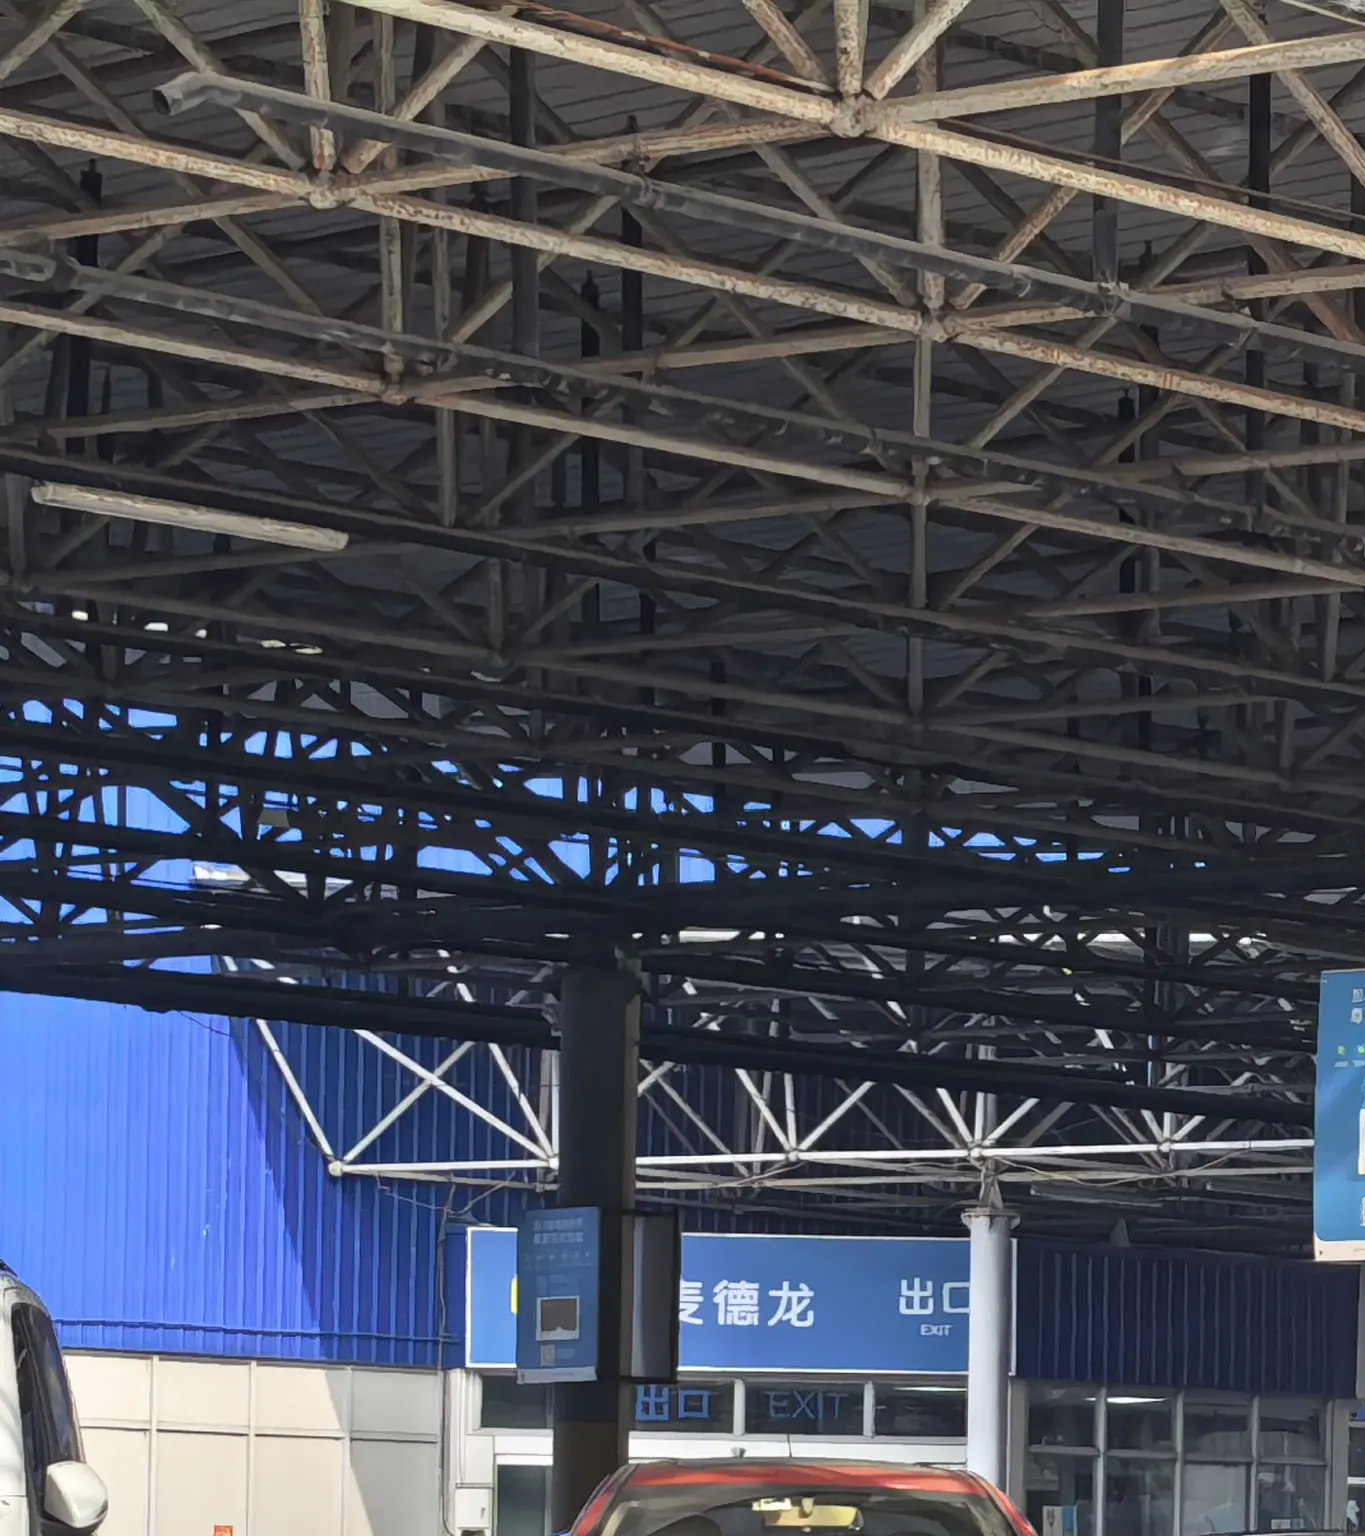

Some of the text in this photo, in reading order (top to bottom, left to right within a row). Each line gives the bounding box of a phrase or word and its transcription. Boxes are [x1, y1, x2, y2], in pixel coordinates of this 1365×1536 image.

[679, 1276, 970, 1328] 麦德龙 出口
[920, 1323, 953, 1337] EXIT
[635, 1384, 849, 1421] 出口 EXIT
